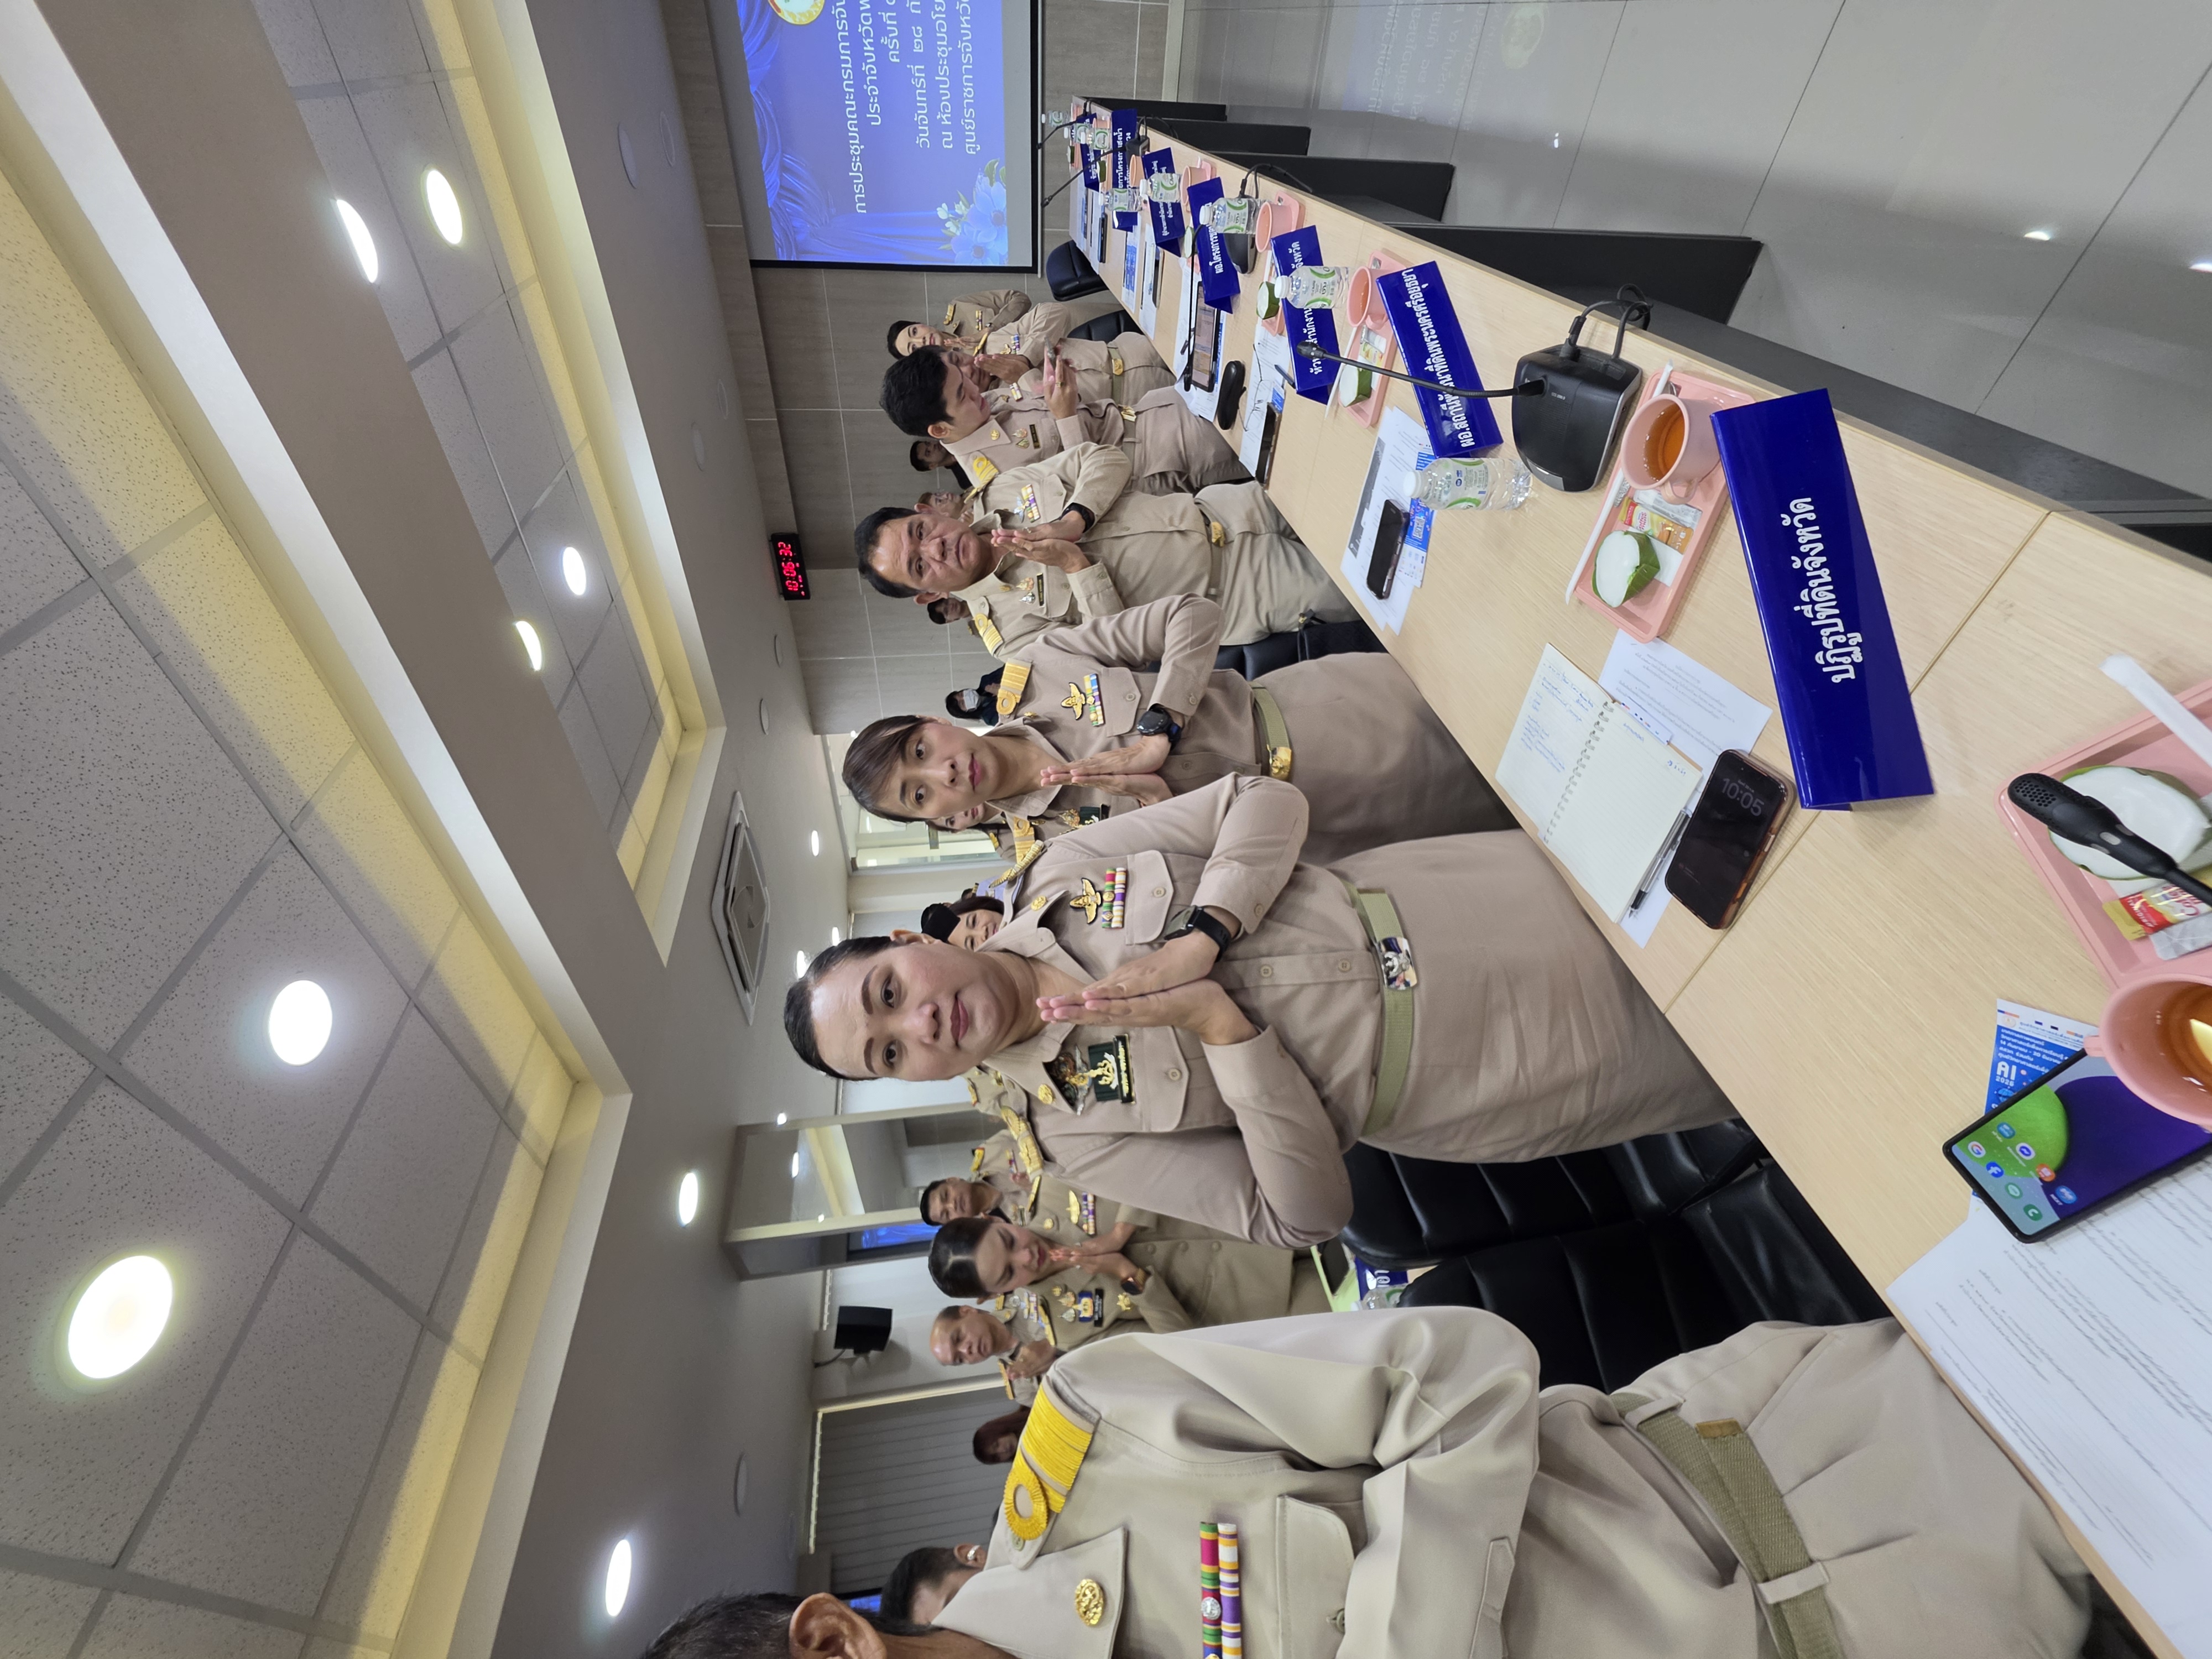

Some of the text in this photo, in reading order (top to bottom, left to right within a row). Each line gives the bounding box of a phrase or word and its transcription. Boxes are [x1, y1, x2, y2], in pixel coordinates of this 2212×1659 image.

[878, 11, 900, 63] ครั้งที่
[911, 25, 924, 53] ๒๘
[956, 0, 980, 155] ศูนย์ราชการจังหวั
[906, 65, 930, 149] วันจันทร์ที่
[940, 131, 953, 149] ณ
[1781, 497, 1863, 683] ปฏิรูปที่ดินจังหวัด
[1721, 776, 1765, 817] 10:05
[1997, 1061, 2017, 1080] AI
